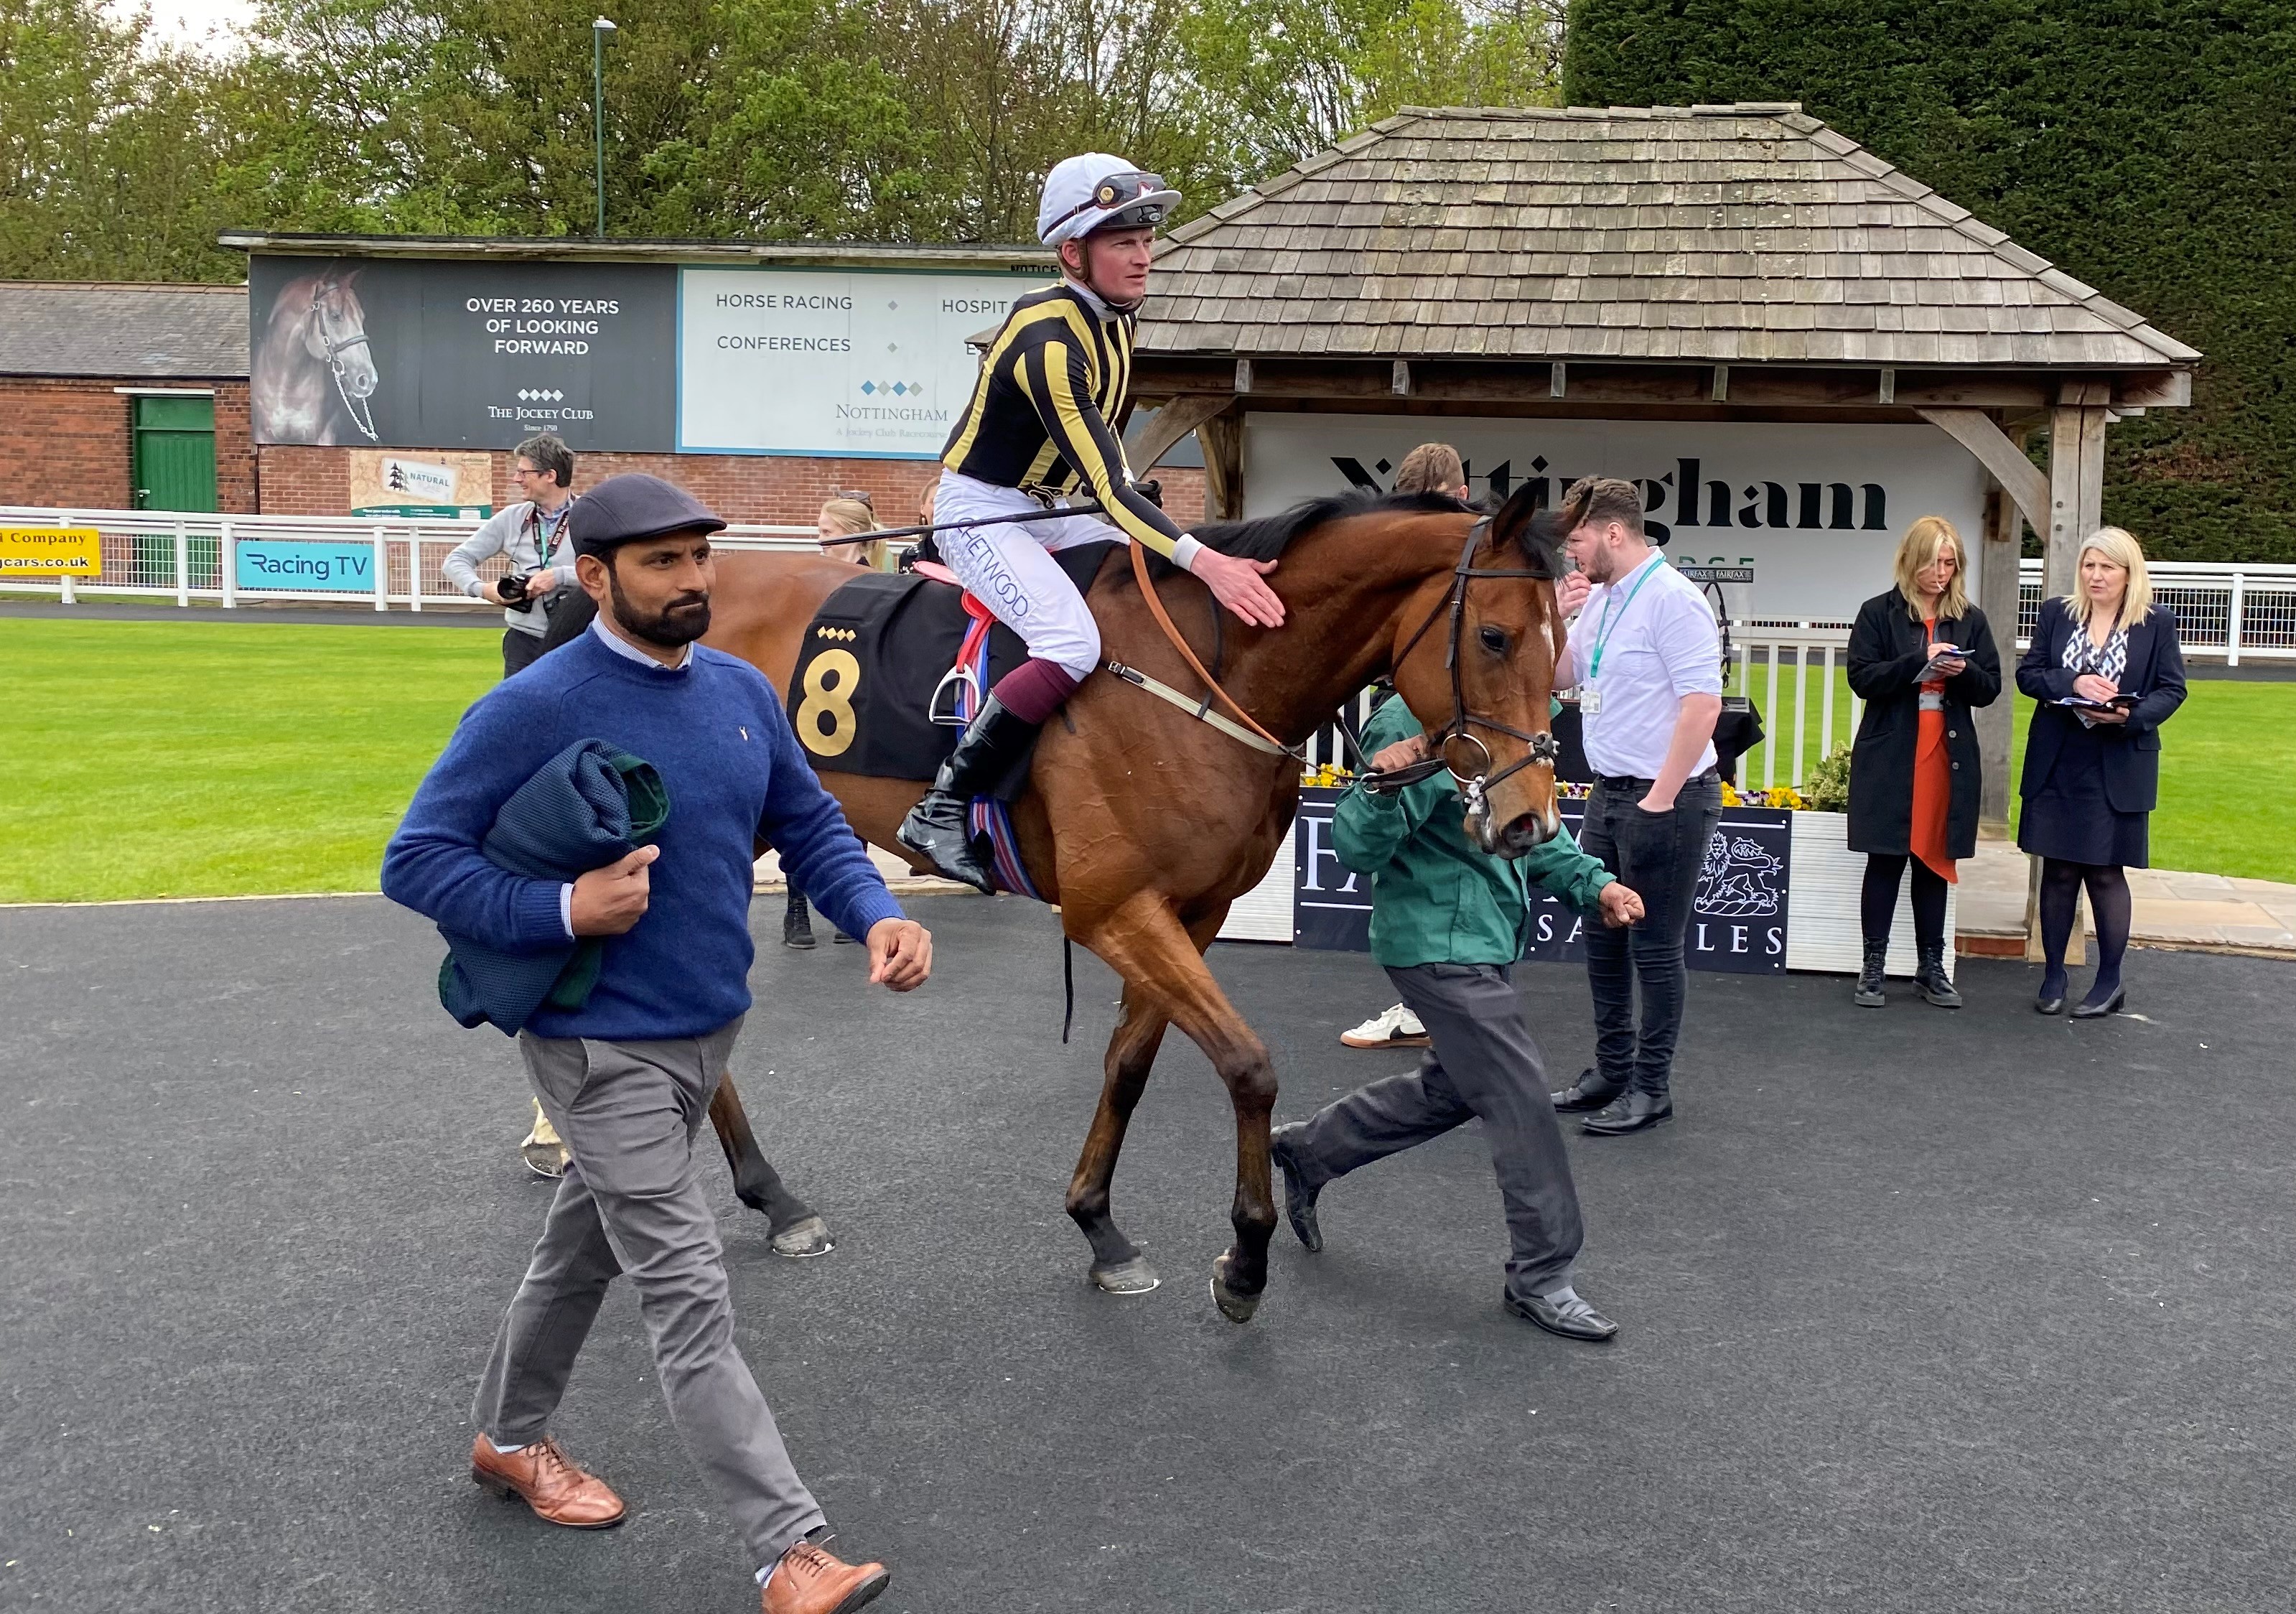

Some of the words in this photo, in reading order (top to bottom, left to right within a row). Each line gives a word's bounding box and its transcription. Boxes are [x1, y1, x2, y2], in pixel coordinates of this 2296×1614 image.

[1010, 264, 1062, 273] NOTICE
[466, 298, 516, 312] OVER
[521, 299, 554, 313] 260
[559, 299, 620, 314] YEARS
[717, 294, 777, 308] HORSE
[783, 295, 852, 309] RACING
[486, 319, 511, 332] OF
[516, 319, 599, 335] LOOKING
[495, 340, 589, 355] FORWARD
[717, 335, 851, 352] CONFERENCES
[488, 406, 513, 418] THE
[515, 406, 559, 421] JOCKEY
[561, 407, 594, 420] CLUB
[835, 404, 948, 421] NOTTINGHAM
[846, 427, 872, 438] Jockey
[875, 428, 897, 438] Club
[899, 429, 948, 439] Racecourse
[410, 472, 449, 487] NATURAL
[10, 532, 86, 546] Company
[0, 557, 89, 569] cars.co.uk
[246, 554, 330, 581] Racing
[335, 556, 368, 576] TV
[958, 517, 1028, 617] CHETWOOD
[1682, 569, 1708, 579] AIRFAX
[1716, 569, 1744, 579] FAIRFAX
[796, 648, 860, 757] 8
[1536, 914, 1783, 955] SALES
